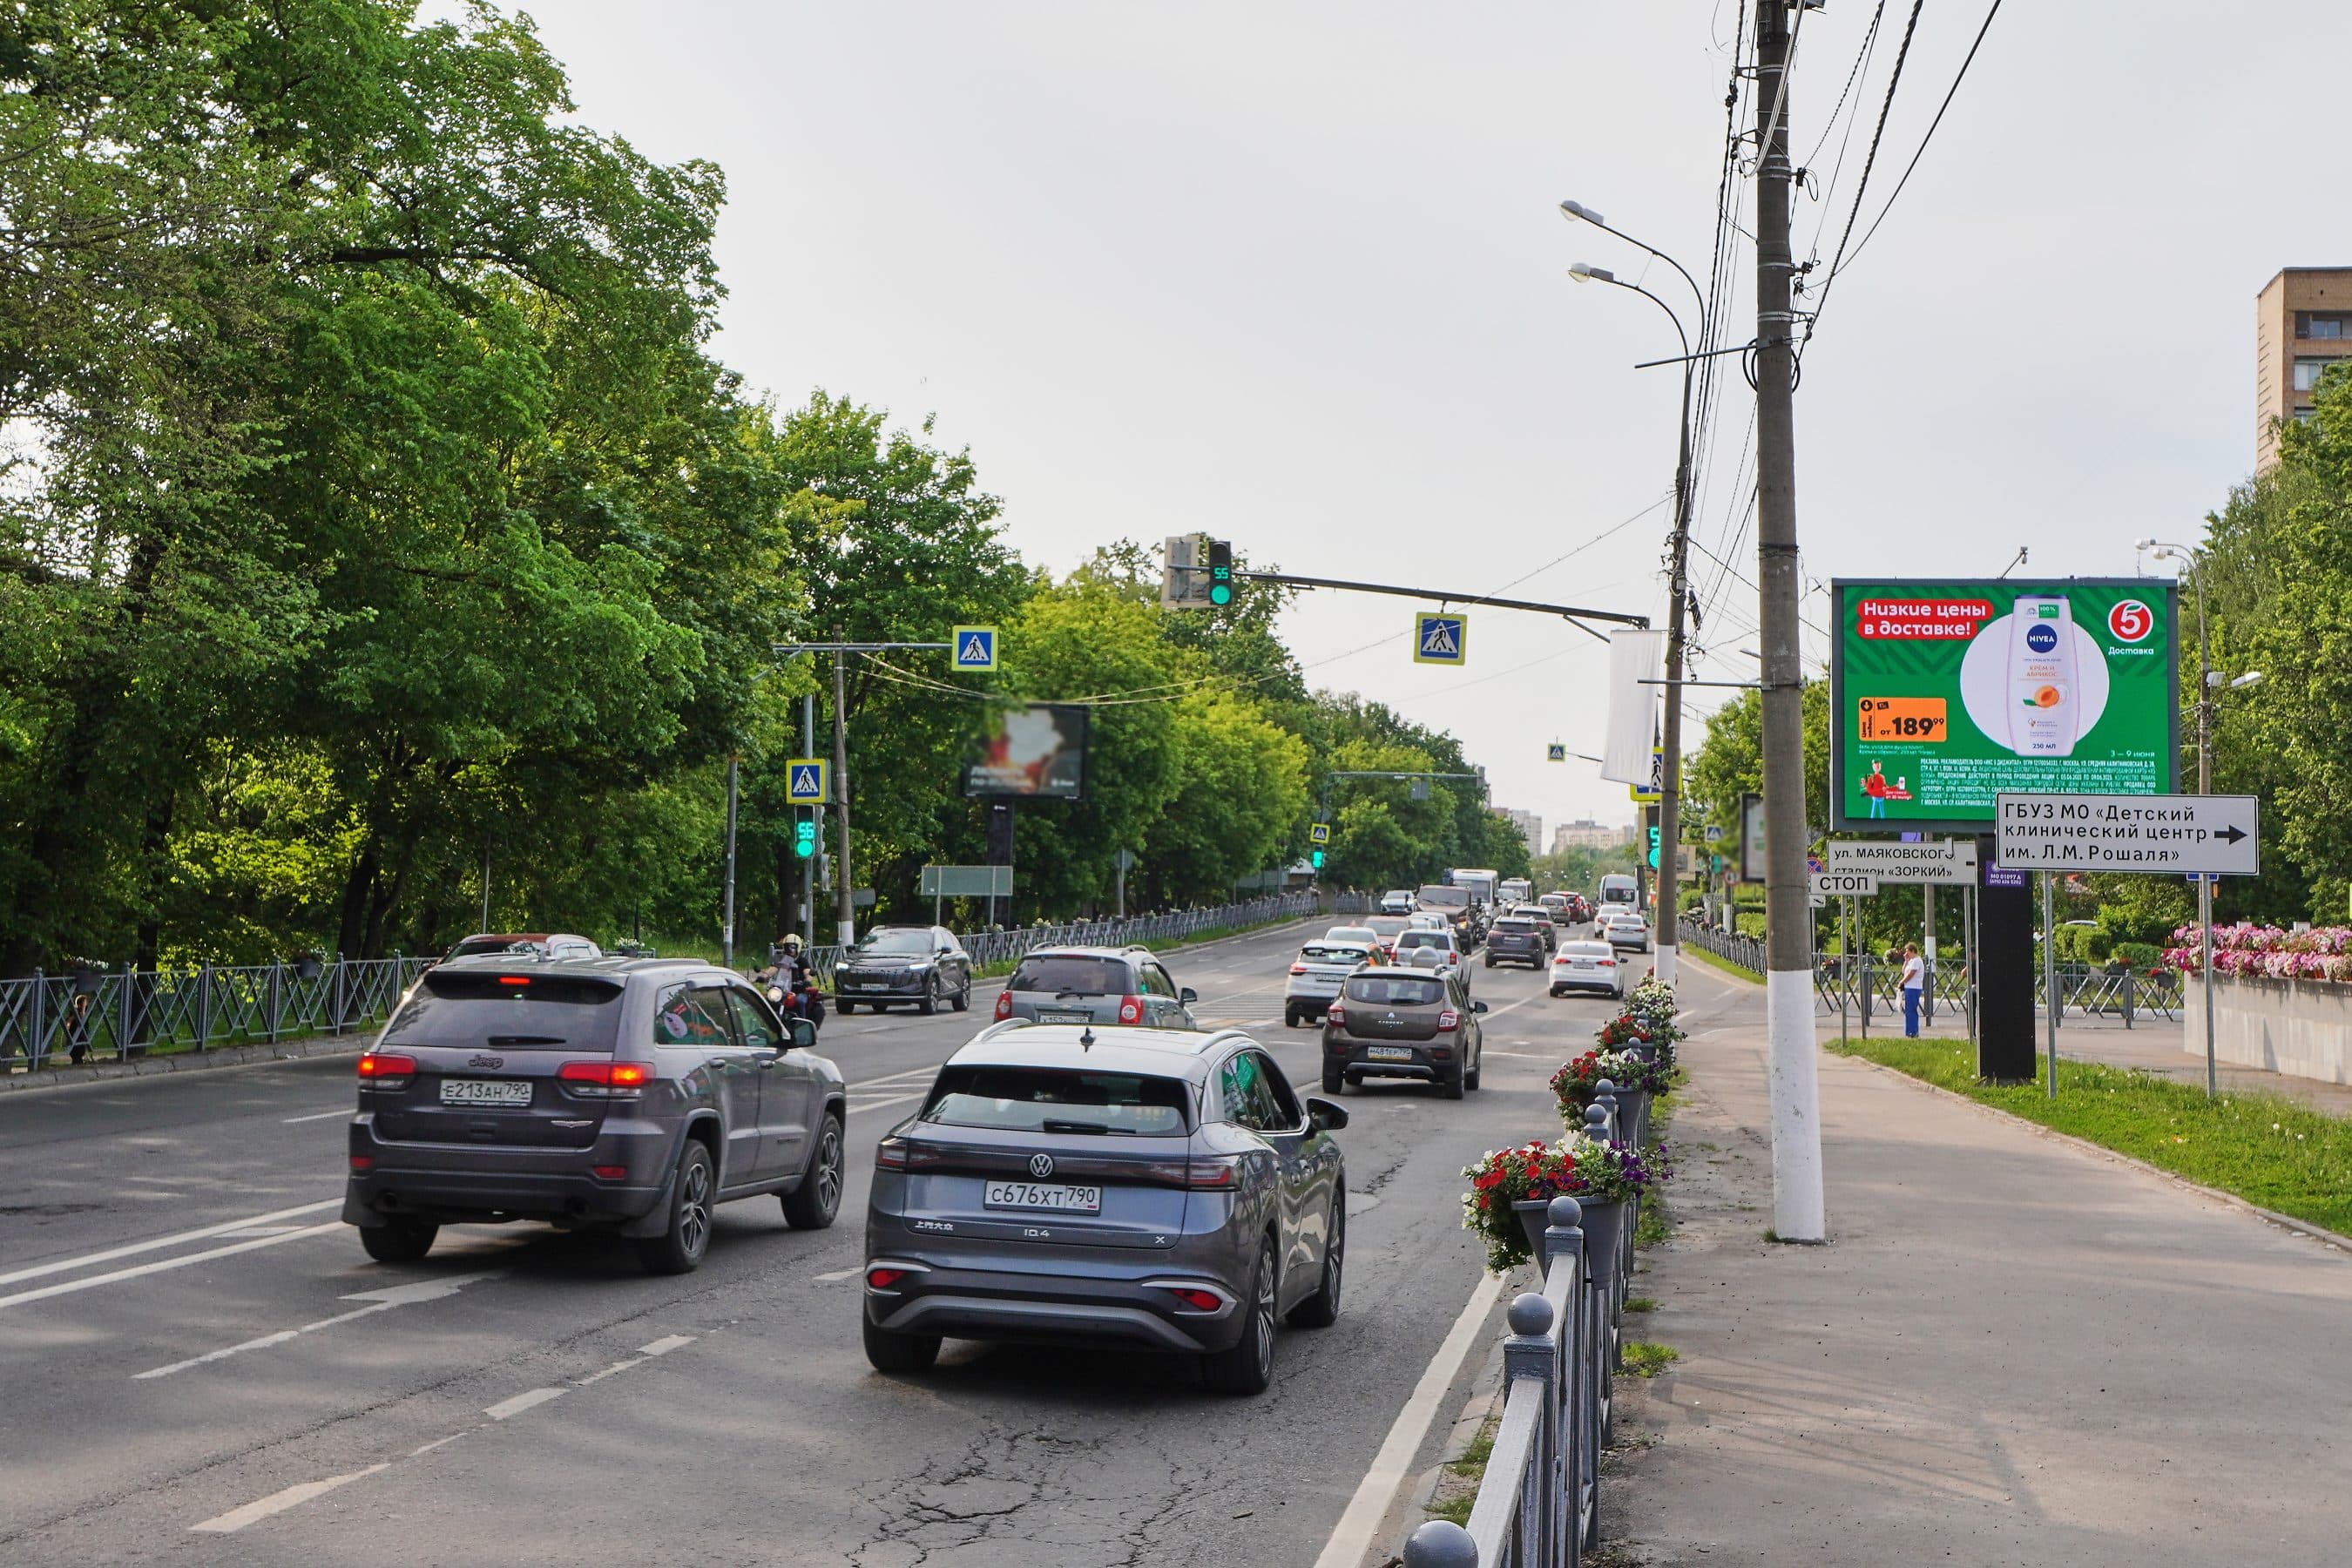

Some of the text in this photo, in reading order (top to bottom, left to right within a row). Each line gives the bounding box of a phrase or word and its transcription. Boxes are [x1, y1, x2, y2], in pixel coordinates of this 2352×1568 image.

[1214, 567, 1228, 579] 55
[1864, 602, 1986, 618] Низкие цены
[1864, 620, 1970, 635] в доставке!
[2108, 646, 2154, 655] Доставка
[2005, 803, 2194, 821] ГБУЗ МО «Детский
[798, 822, 814, 840] 56
[2005, 824, 2207, 843] клинический центр
[1835, 850, 1852, 860] ул.
[2005, 845, 2180, 862] им. Л.М. Рошаля»
[1889, 865, 1952, 877] «ЗОРКИЙ»
[1820, 876, 1869, 890] СТОП
[468, 1054, 504, 1070] Jeep
[991, 1185, 1096, 1206] С676ХТ 790
